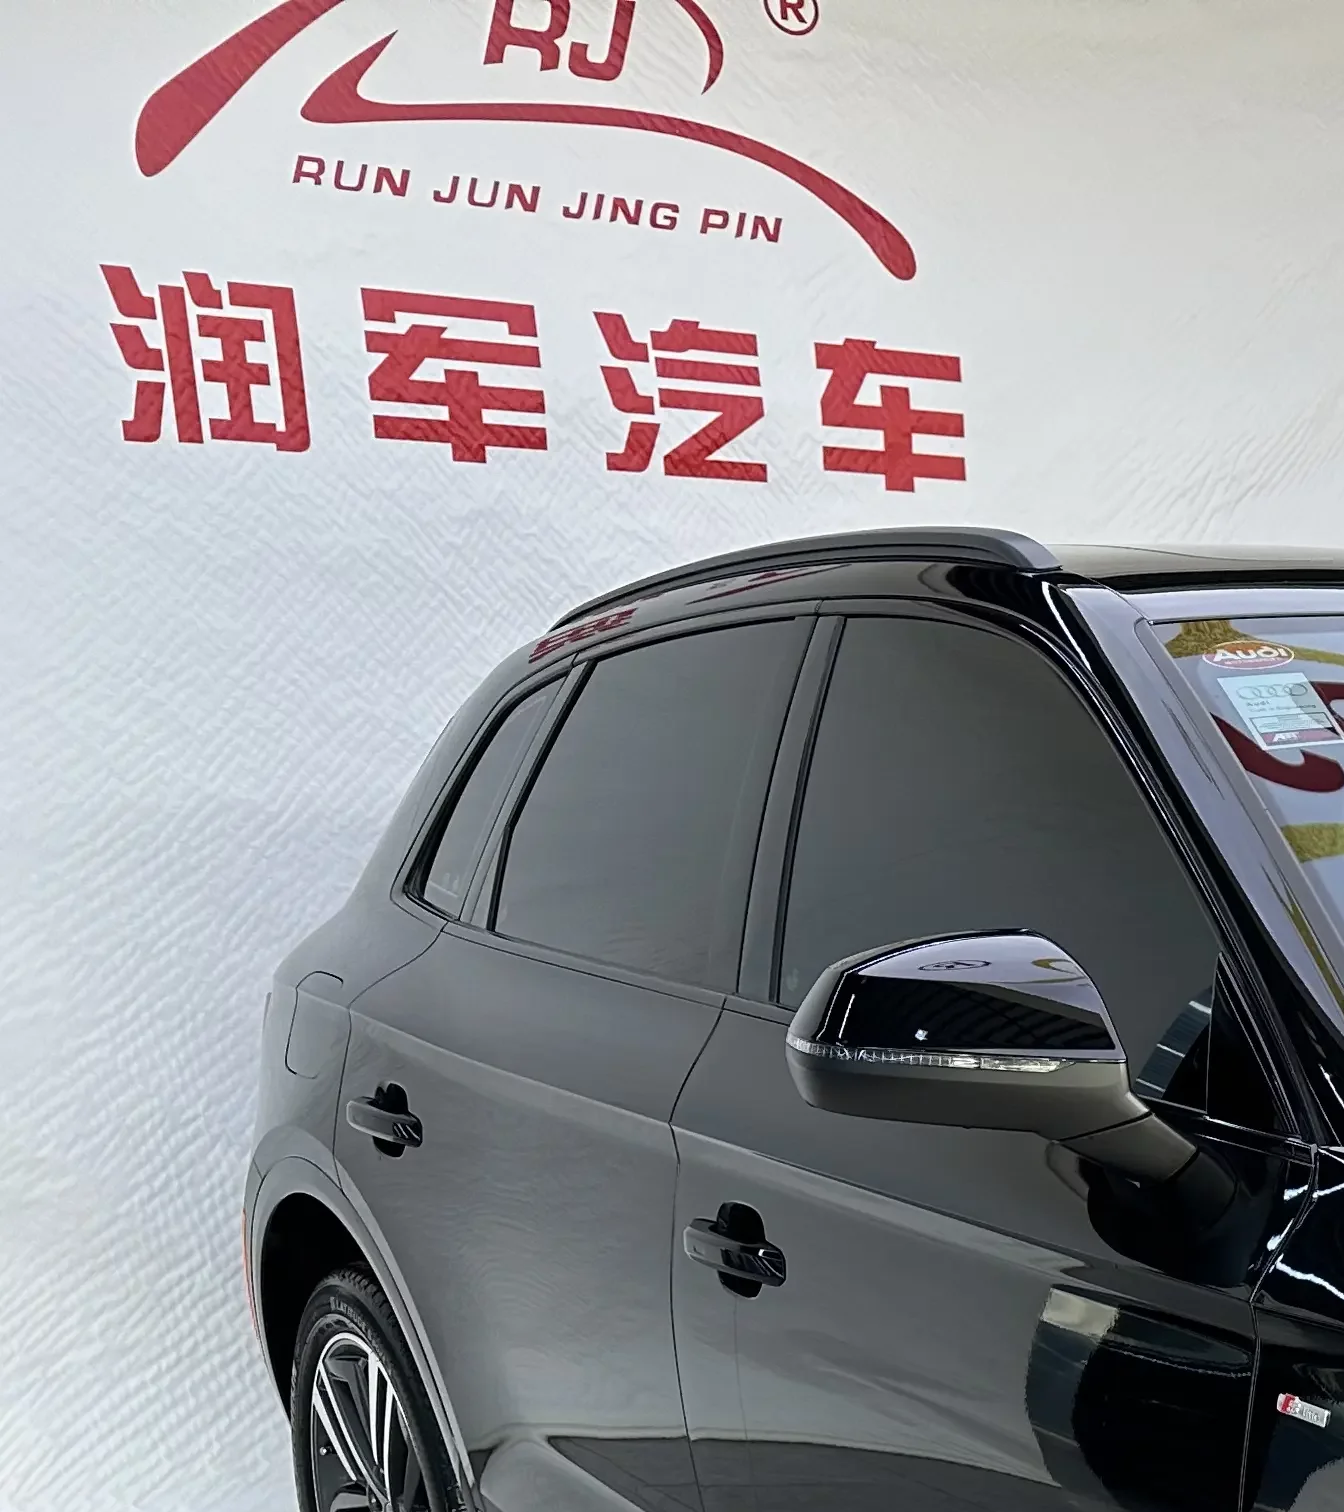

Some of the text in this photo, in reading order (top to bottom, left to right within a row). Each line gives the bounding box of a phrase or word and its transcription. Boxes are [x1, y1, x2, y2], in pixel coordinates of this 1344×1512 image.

[292, 154, 783, 244] RUN JUN JING PIN
[98, 262, 968, 494] 润军汽车
[1213, 645, 1290, 662] Audi
